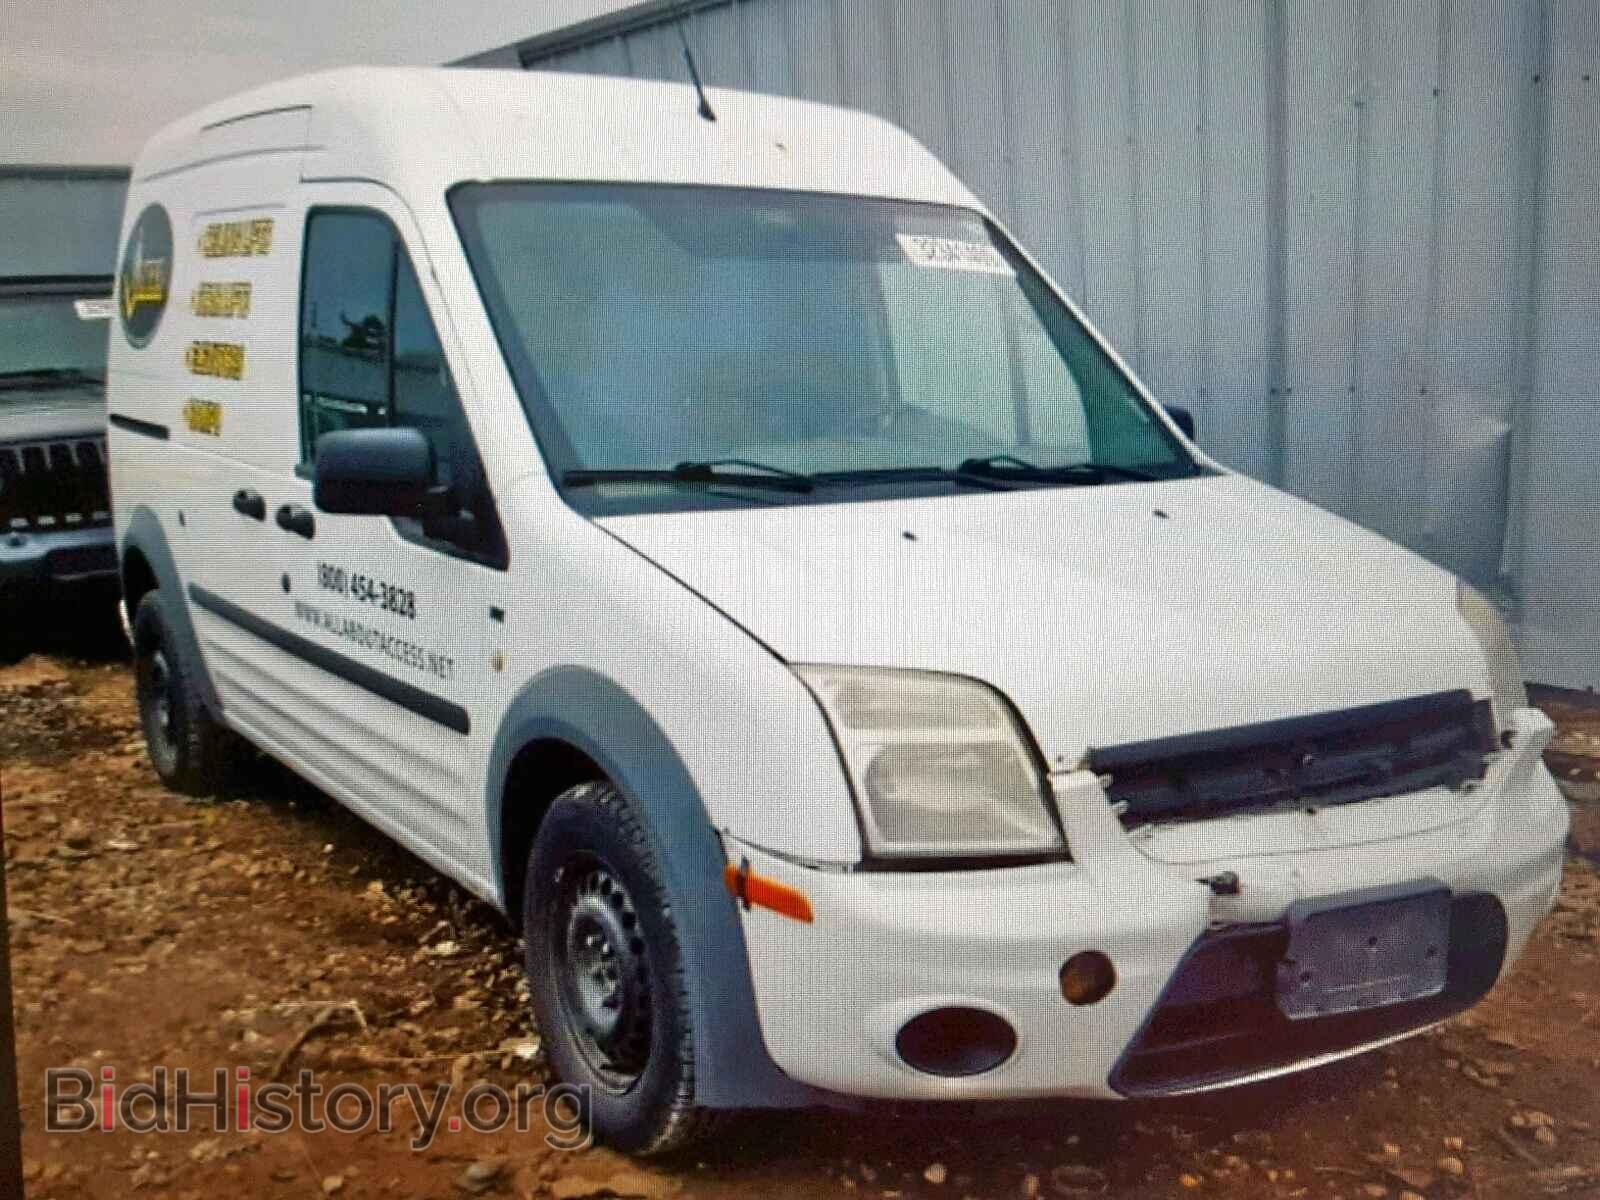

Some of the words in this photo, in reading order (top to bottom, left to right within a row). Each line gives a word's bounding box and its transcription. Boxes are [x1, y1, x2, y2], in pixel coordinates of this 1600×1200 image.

[317, 561, 348, 597] (800)
[351, 573, 417, 620] 454-3828
[294, 600, 455, 680] WWW.ALLABOUTACCESS.NET
